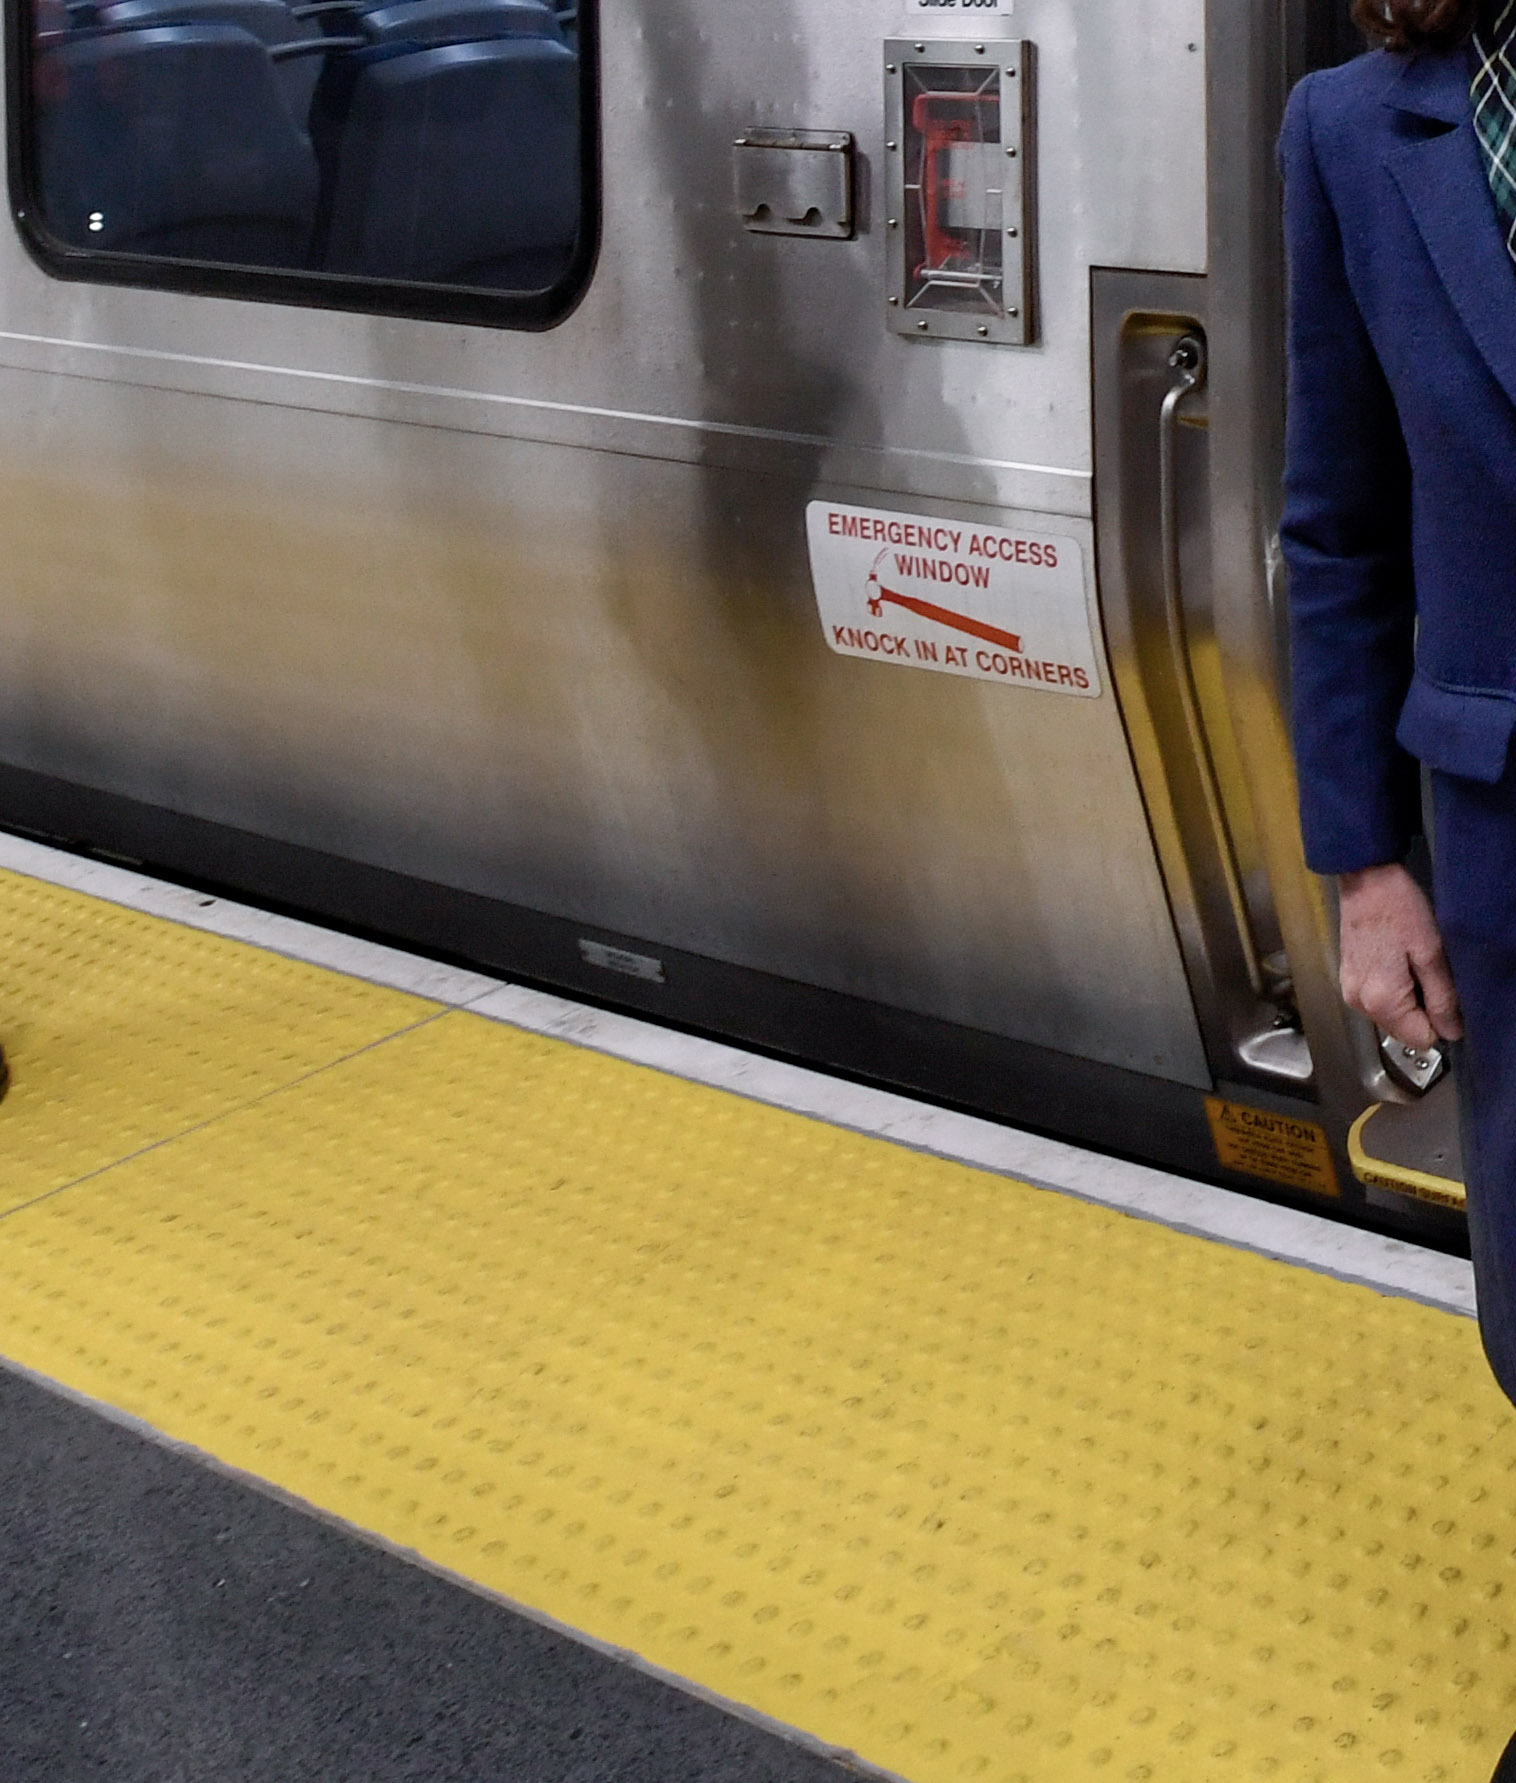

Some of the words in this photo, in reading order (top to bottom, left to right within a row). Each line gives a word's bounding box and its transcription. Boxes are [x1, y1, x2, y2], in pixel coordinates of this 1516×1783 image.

[828, 512, 962, 554] EMERGENCY
[968, 533, 1058, 568] ACCESS
[894, 552, 990, 589] WINDOW
[832, 624, 910, 658] KNOCK
[914, 639, 938, 663] IN
[944, 645, 968, 667] AT
[975, 650, 1090, 690] CORNERS
[1241, 1110, 1316, 1144] CAUTION
